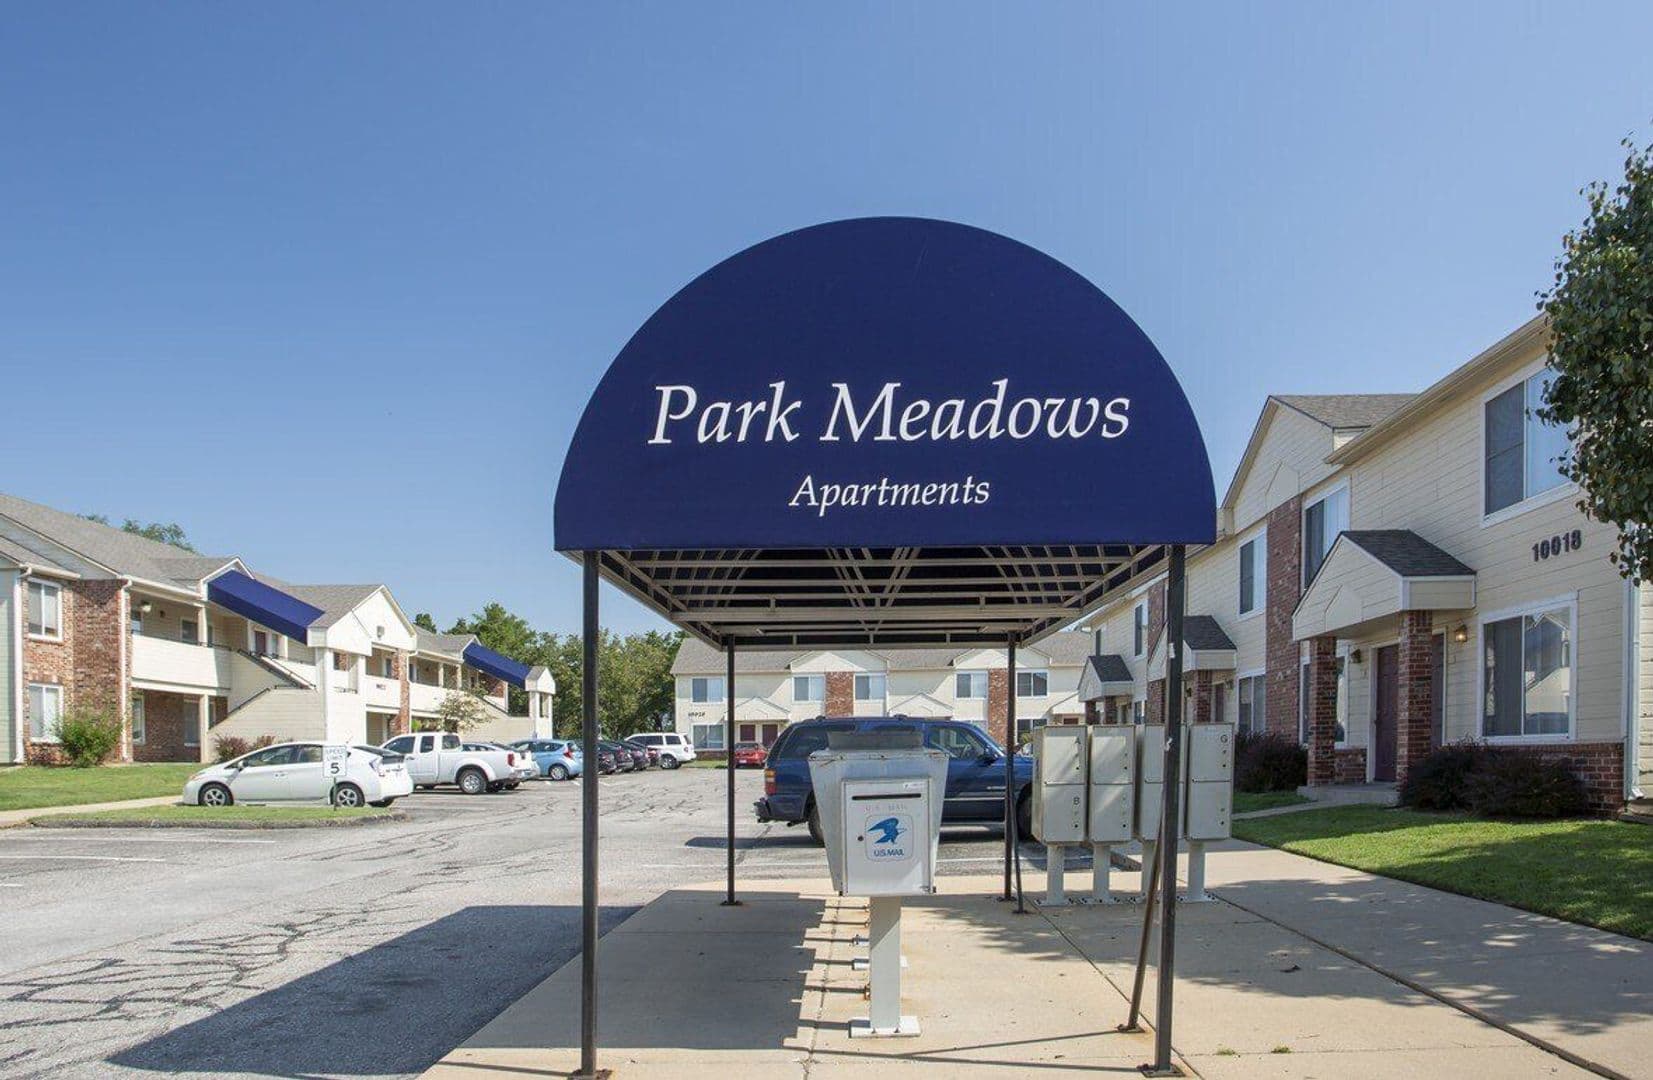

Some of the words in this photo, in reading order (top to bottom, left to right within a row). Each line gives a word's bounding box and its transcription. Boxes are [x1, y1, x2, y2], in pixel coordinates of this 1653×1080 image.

[647, 380, 802, 443] Park
[819, 378, 1130, 442] Meadows
[788, 475, 990, 516] Apartments
[1532, 529, 1582, 562] 10018
[330, 762, 340, 775] 5
